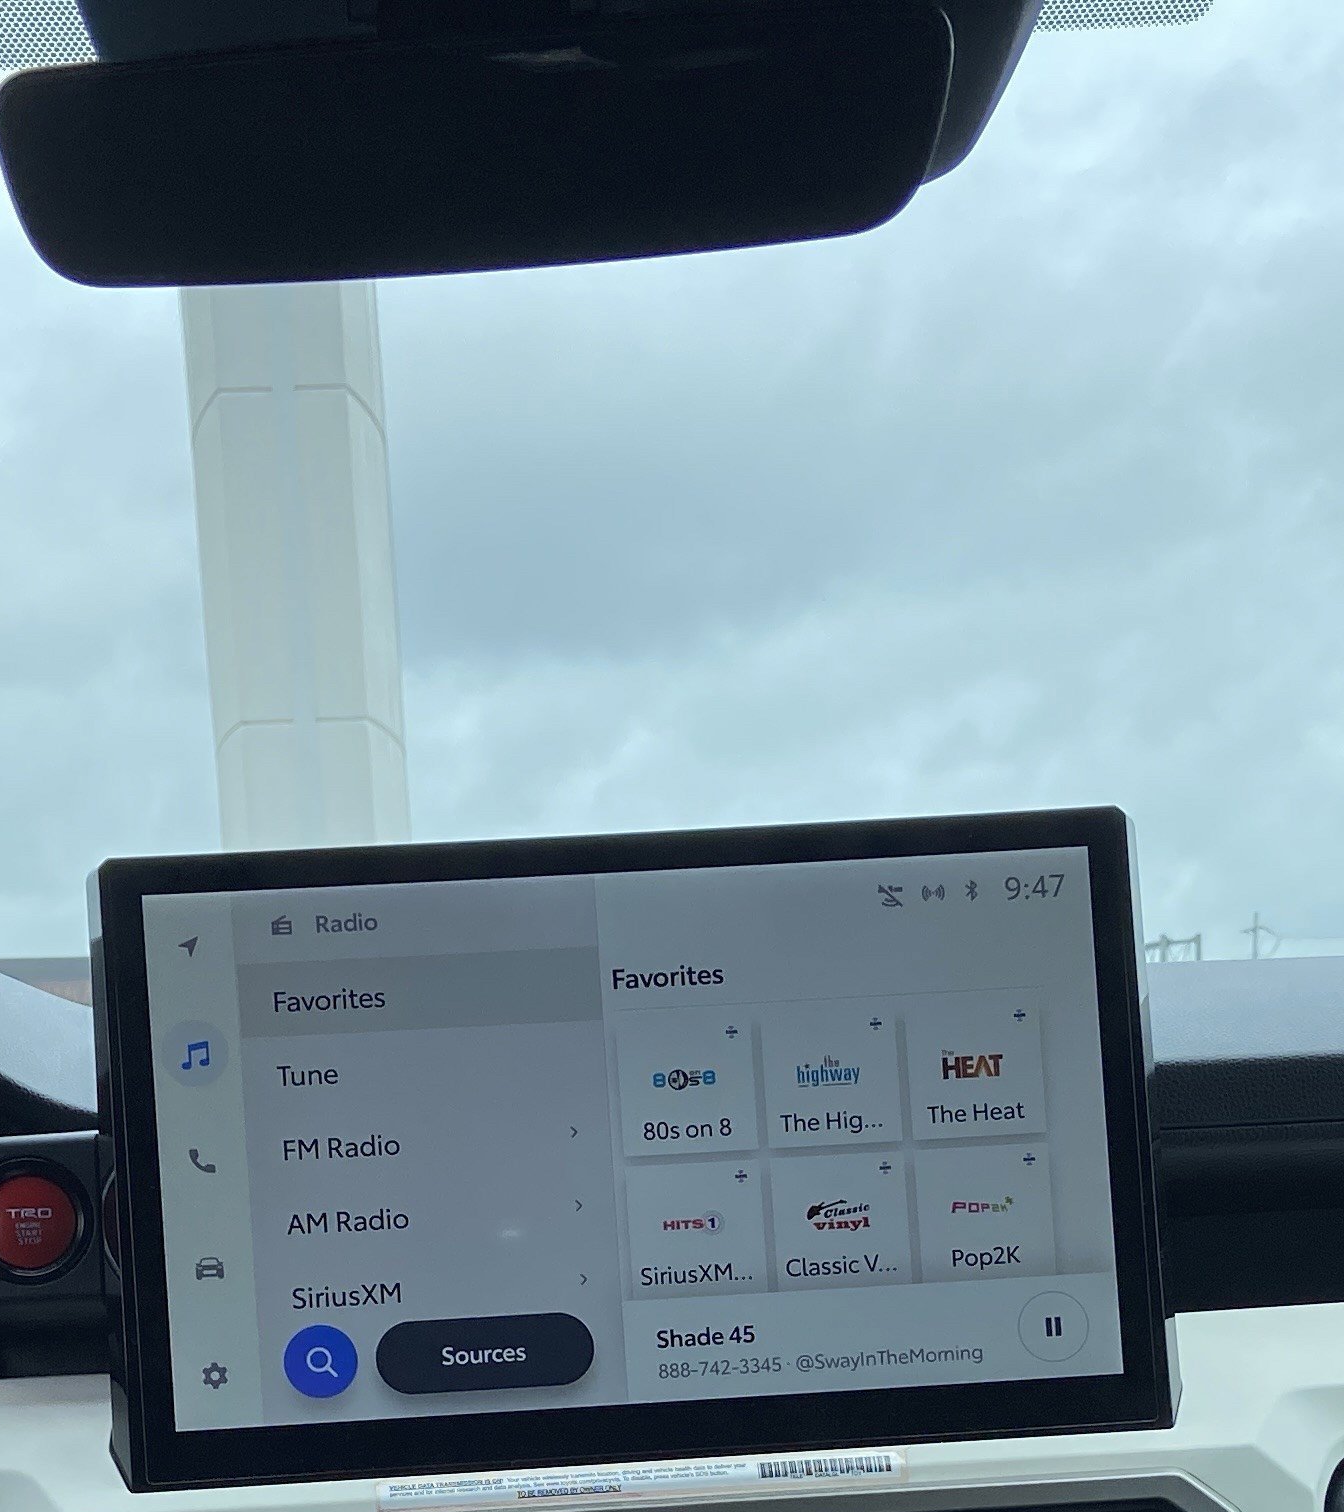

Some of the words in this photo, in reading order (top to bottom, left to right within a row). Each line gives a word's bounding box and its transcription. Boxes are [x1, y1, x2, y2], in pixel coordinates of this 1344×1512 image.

[1004, 874, 1065, 900] 9:47
[315, 912, 378, 934] Radio
[611, 964, 724, 991] Favorites
[273, 988, 386, 1013] Favorites
[823, 1055, 840, 1068] the
[941, 1054, 1003, 1080] HEAT
[276, 1065, 339, 1087] Tune
[796, 1063, 860, 1086] highway
[780, 1114, 820, 1133] The
[826, 1111, 884, 1134] Hig...
[927, 1105, 967, 1124] The
[973, 1102, 1026, 1121] Heat
[643, 1121, 680, 1140] 80s
[686, 1123, 713, 1138] on
[719, 1118, 732, 1136] 8
[283, 1138, 320, 1161] FM
[327, 1135, 401, 1159] Radio
[6, 1207, 52, 1219] TRD
[287, 1212, 329, 1235] AM
[337, 1209, 409, 1232] Radio
[823, 1203, 870, 1219] Classic
[663, 1217, 704, 1231] HITS
[813, 1216, 871, 1231] vinyl
[786, 1256, 860, 1278] Classic
[951, 1245, 1021, 1271] Pop2K
[640, 1261, 753, 1287] SiriusXM...
[292, 1282, 402, 1309] SiriusXM
[656, 1326, 724, 1349] Shade
[729, 1325, 755, 1344] 45
[441, 1345, 527, 1366] Sources
[658, 1356, 782, 1380] 888-742-3345
[796, 1345, 984, 1373] @SwayInTheMorning
